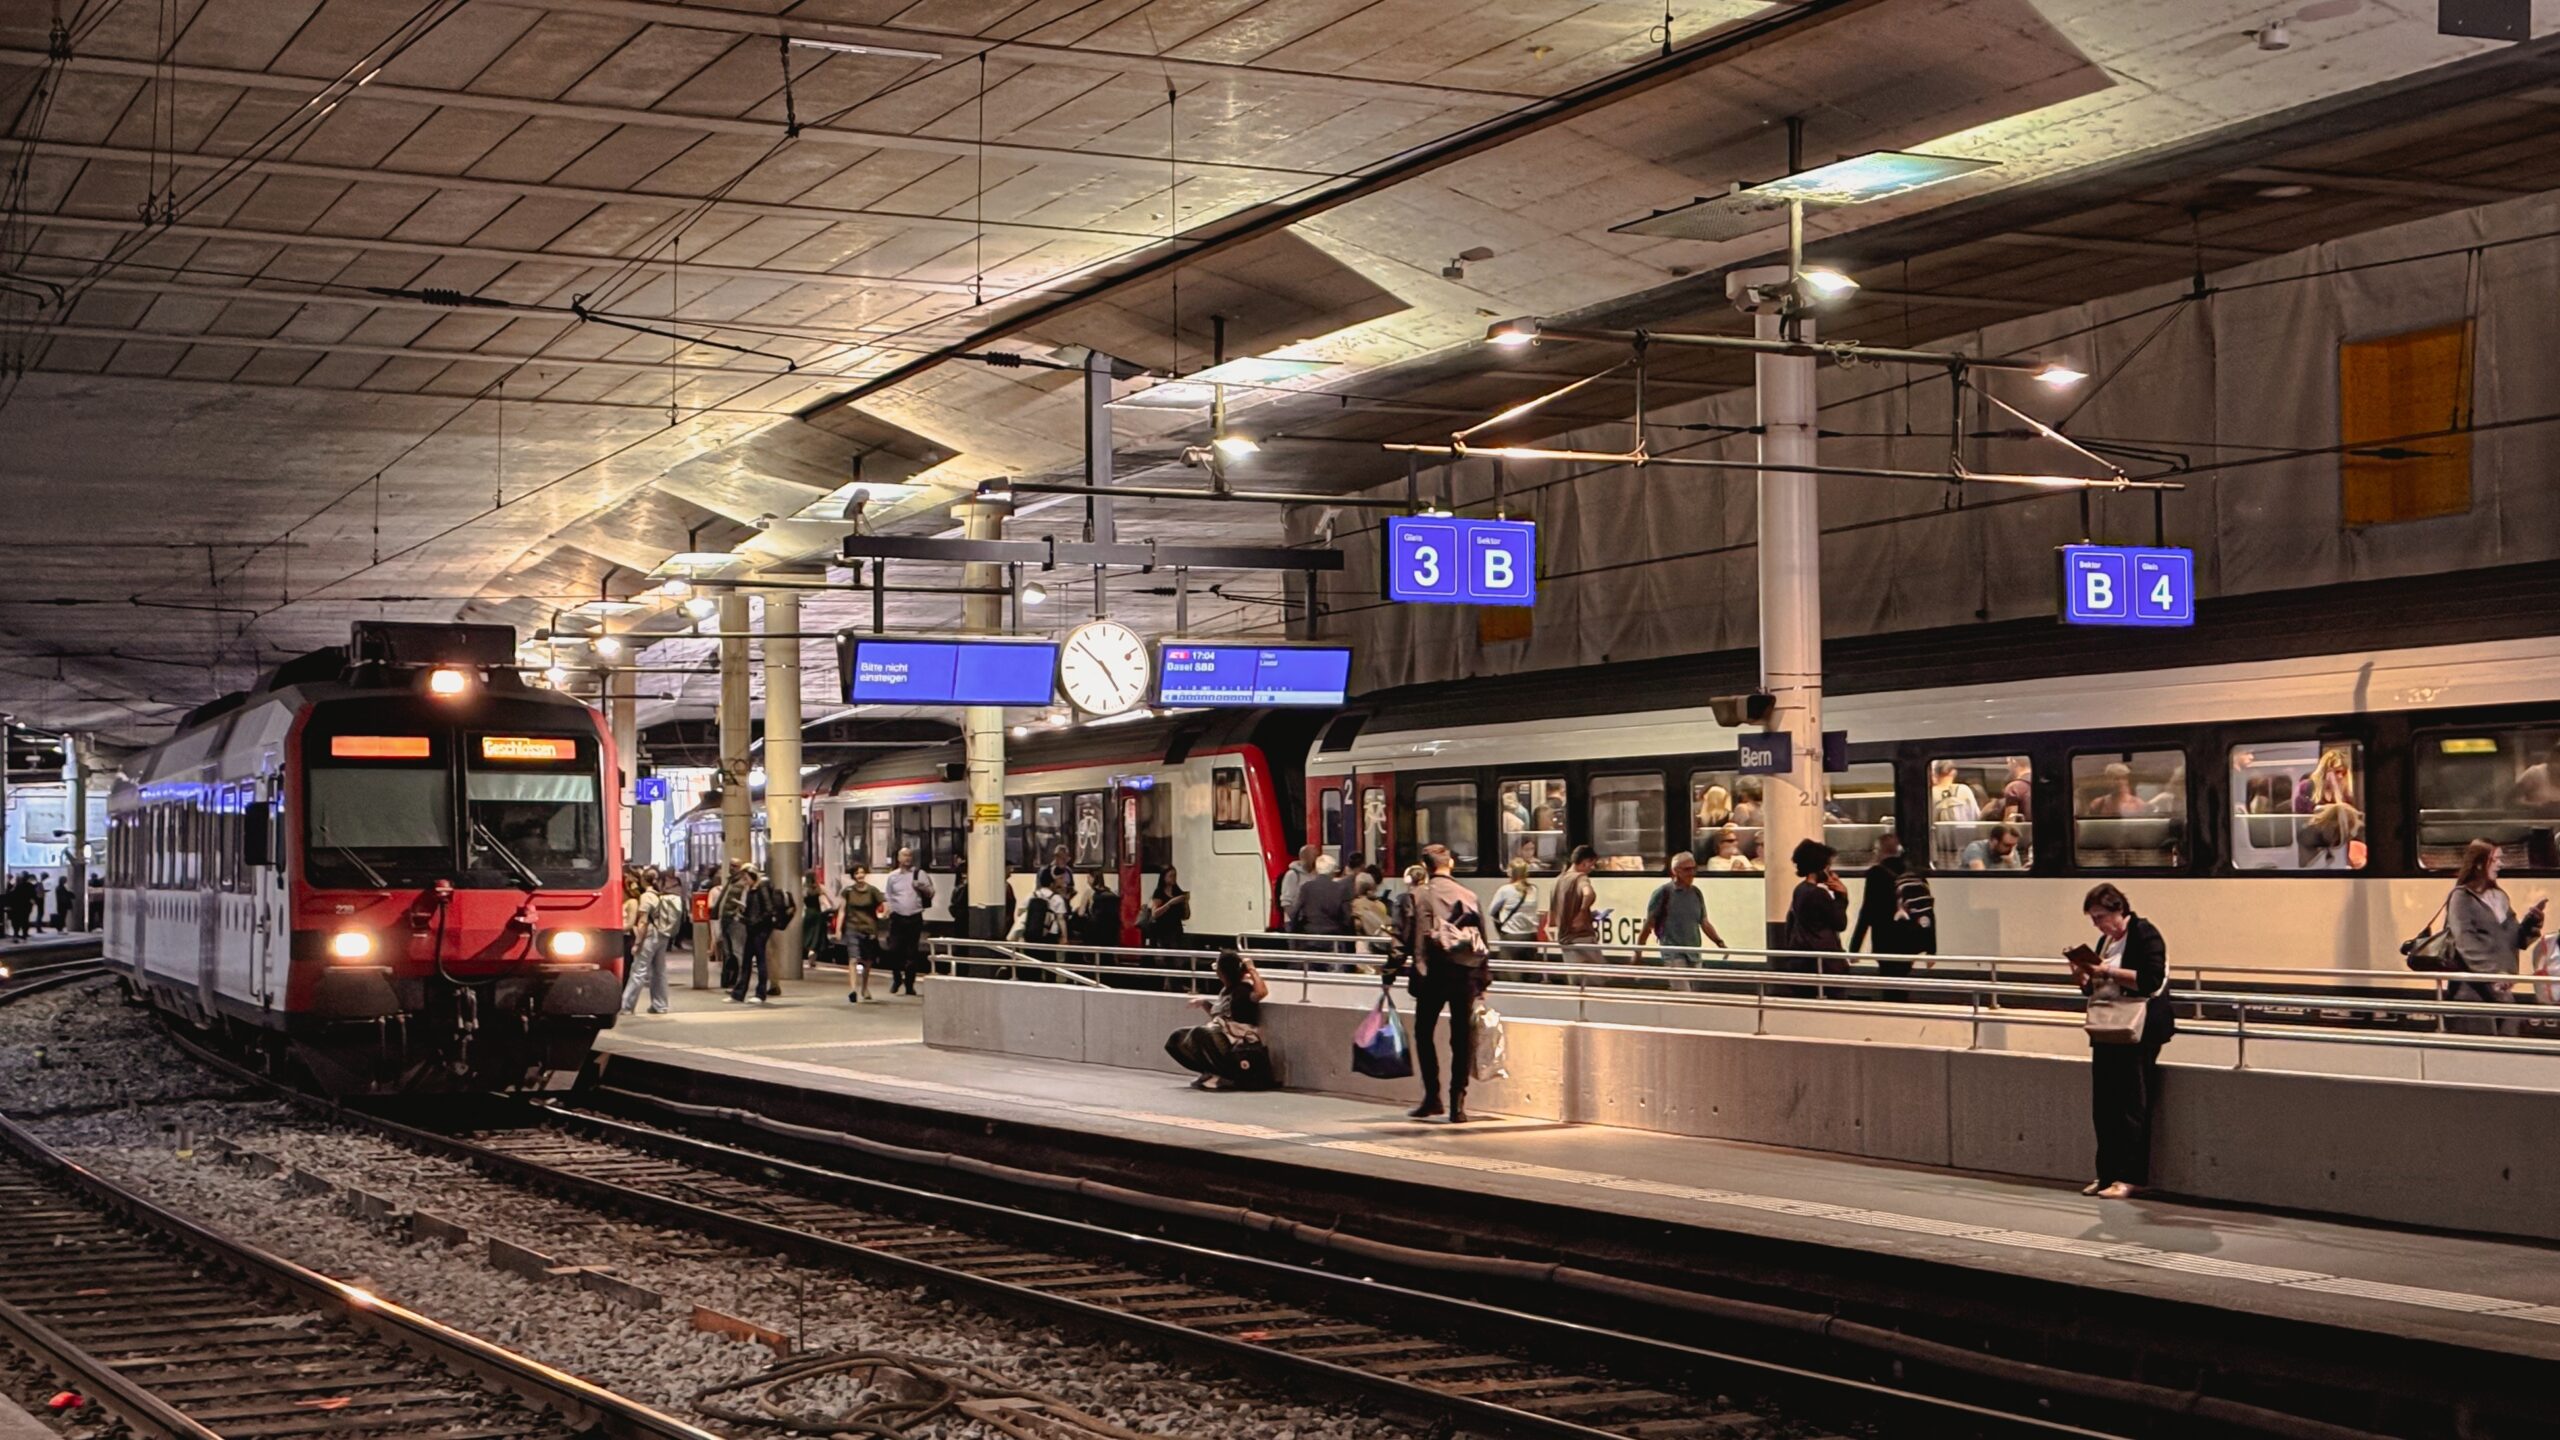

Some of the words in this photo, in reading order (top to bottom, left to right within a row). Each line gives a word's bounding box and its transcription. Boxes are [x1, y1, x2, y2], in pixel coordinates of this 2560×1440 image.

[1477, 536, 1501, 545] Sektor
[1414, 546, 1440, 587] 3
[1485, 549, 1514, 588] B
[2086, 572, 2113, 609] B
[2150, 574, 2173, 610] 4
[1192, 651, 1215, 660] 17:04
[861, 662, 883, 672] Bitte
[885, 663, 908, 672] nicht
[1167, 662, 1193, 671] Basel
[860, 673, 907, 684] einsteigen
[484, 740, 556, 756] Geschlossen
[1740, 746, 1772, 767] Bern
[649, 785, 659, 798] 4
[1344, 779, 1353, 805] 2
